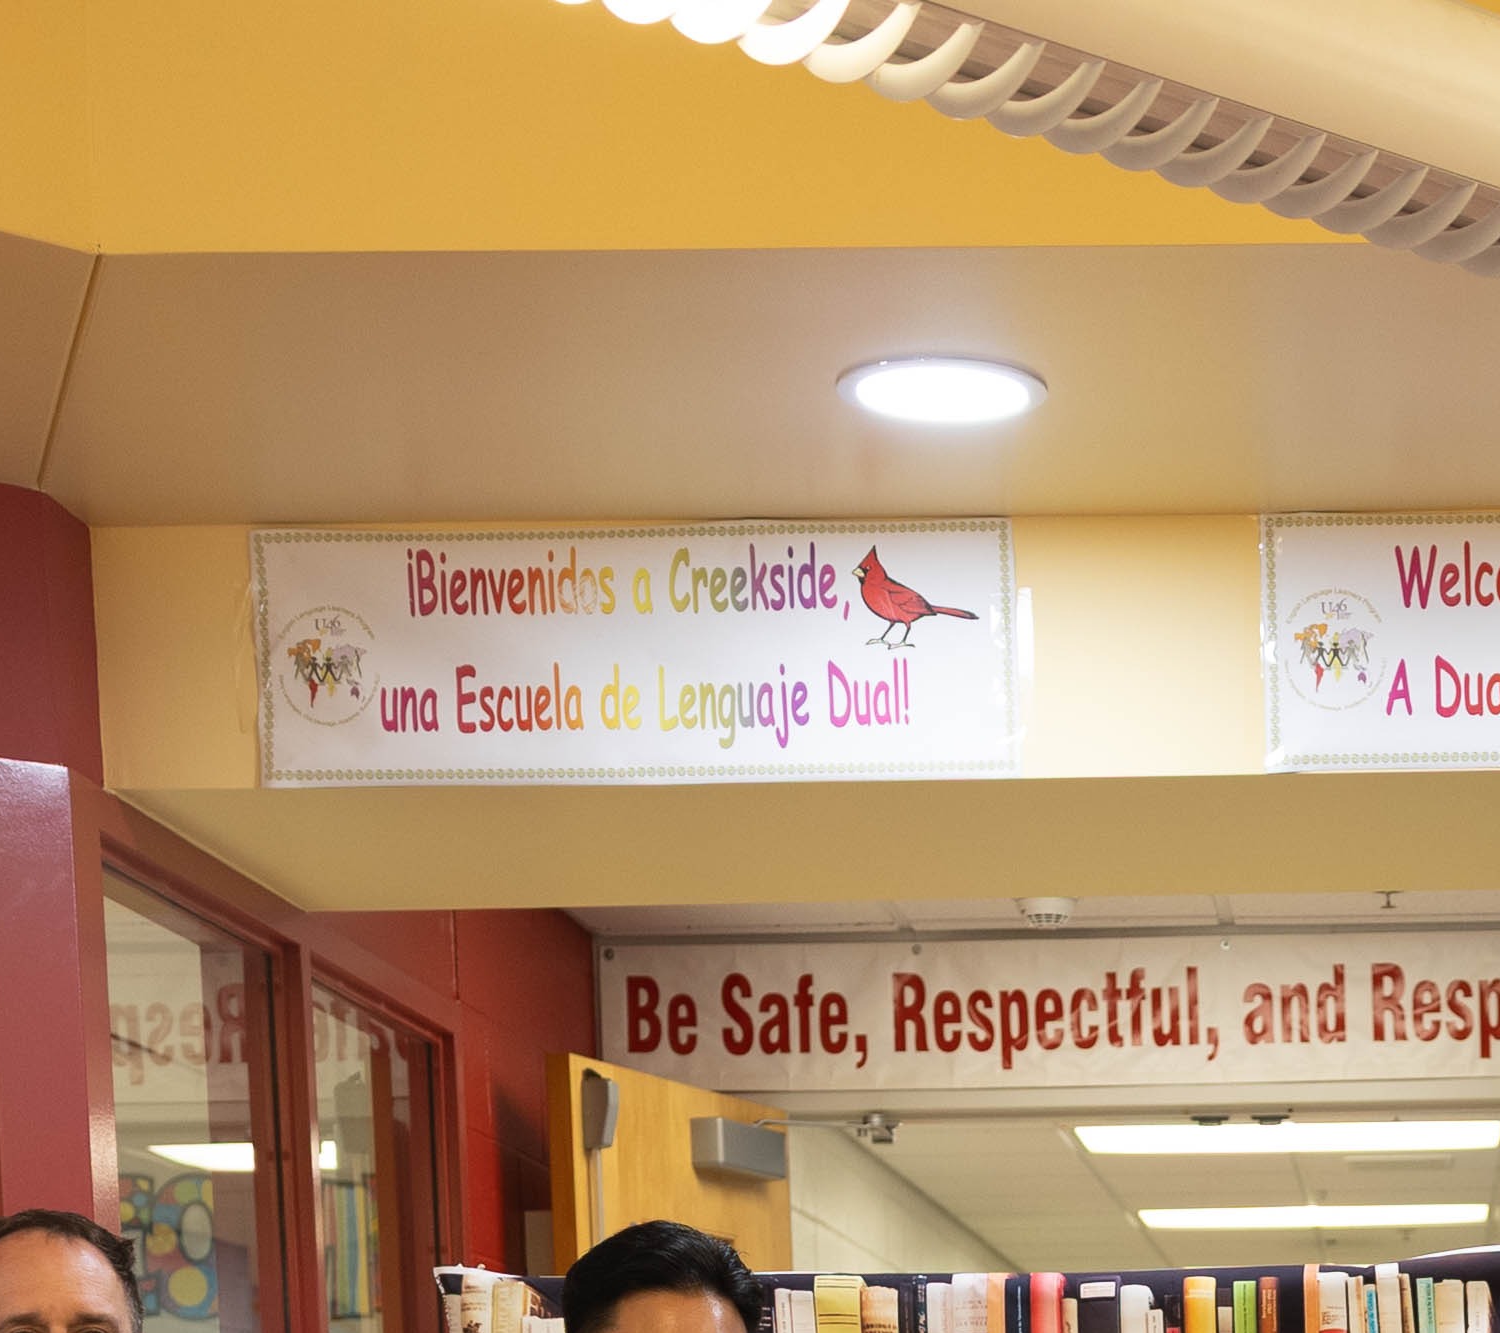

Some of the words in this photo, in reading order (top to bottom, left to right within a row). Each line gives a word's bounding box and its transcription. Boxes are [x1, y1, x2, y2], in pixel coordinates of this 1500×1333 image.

[407, 546, 615, 617] ¡Bienvenidos
[632, 569, 652, 612] a
[668, 542, 850, 620] Creekside,
[380, 681, 437, 733] una
[456, 661, 584, 734] Escuela
[600, 664, 642, 732] de
[658, 663, 809, 749] Lenguaje
[827, 658, 910, 727] Dual!
[1386, 658, 1413, 716] A
[624, 973, 698, 1055] Be
[720, 970, 869, 1069] Safe,
[891, 962, 1219, 1068] Respectful,
[1241, 963, 1346, 1046] and
